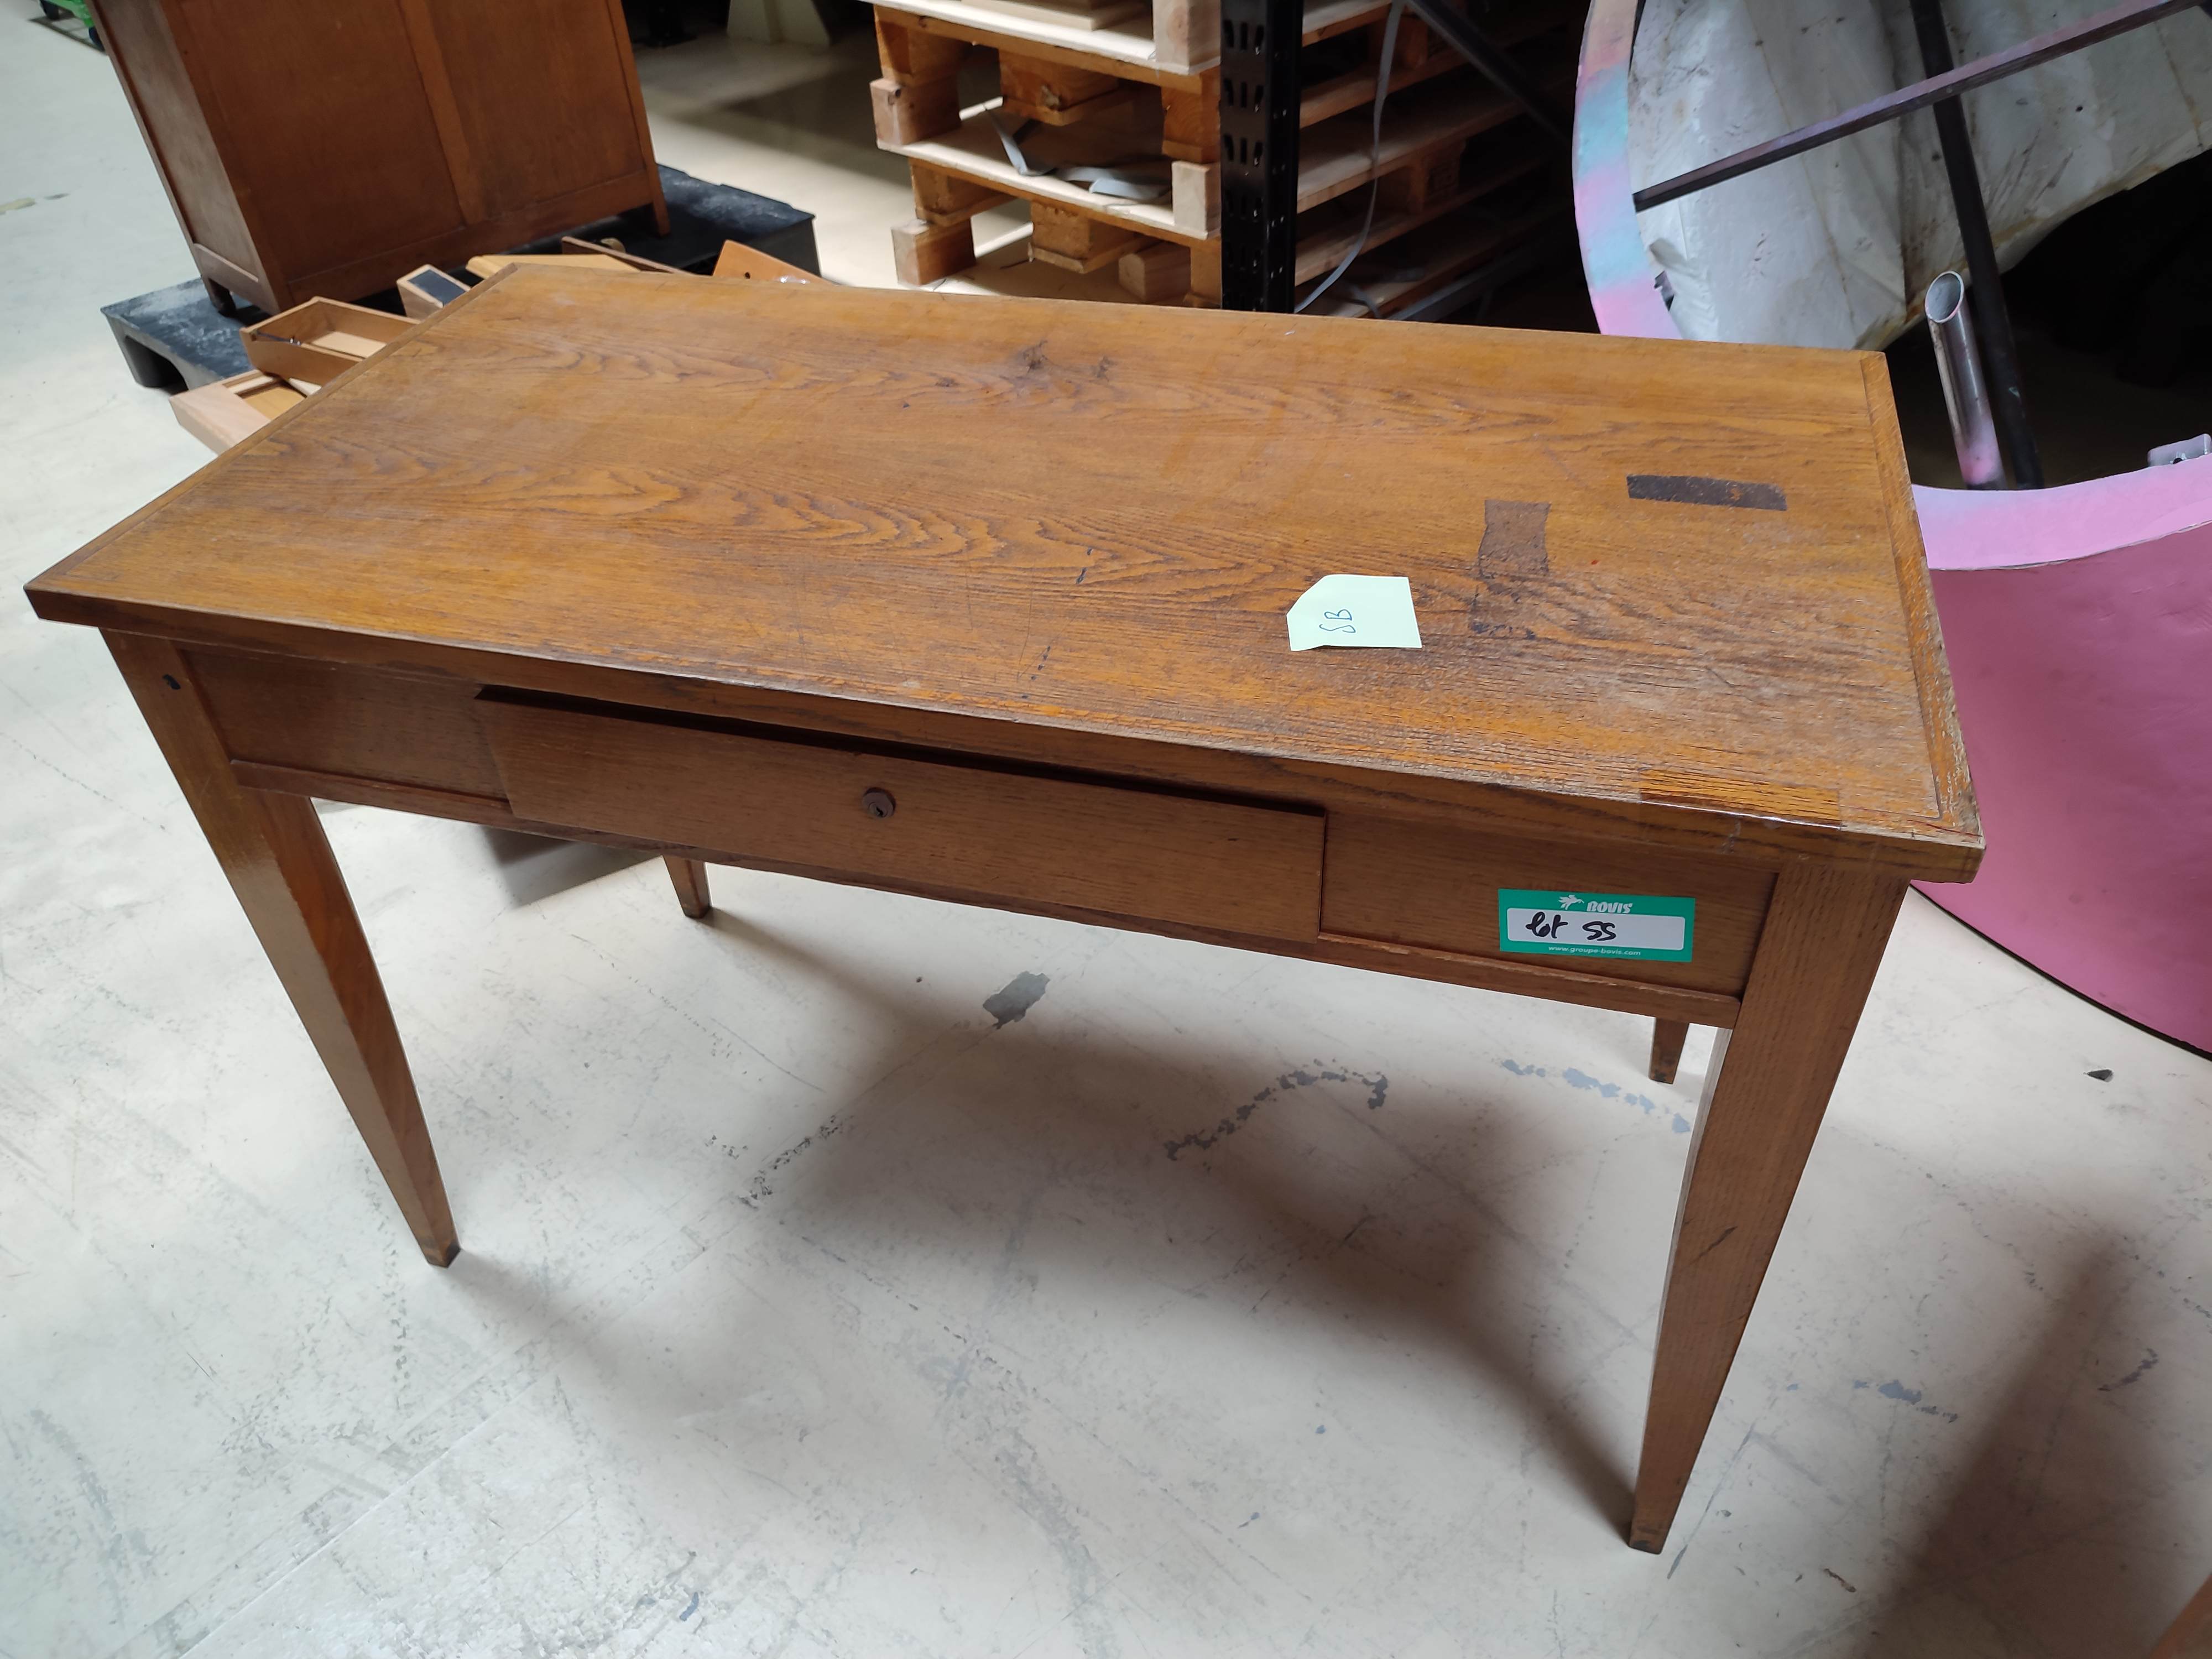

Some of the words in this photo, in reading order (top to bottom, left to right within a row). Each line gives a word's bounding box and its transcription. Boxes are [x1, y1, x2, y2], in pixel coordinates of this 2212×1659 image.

[1587, 900, 1633, 914] BOVIS
[1525, 911, 1568, 939] lot
[1548, 946, 1641, 956] www.groupe-bovis.com
